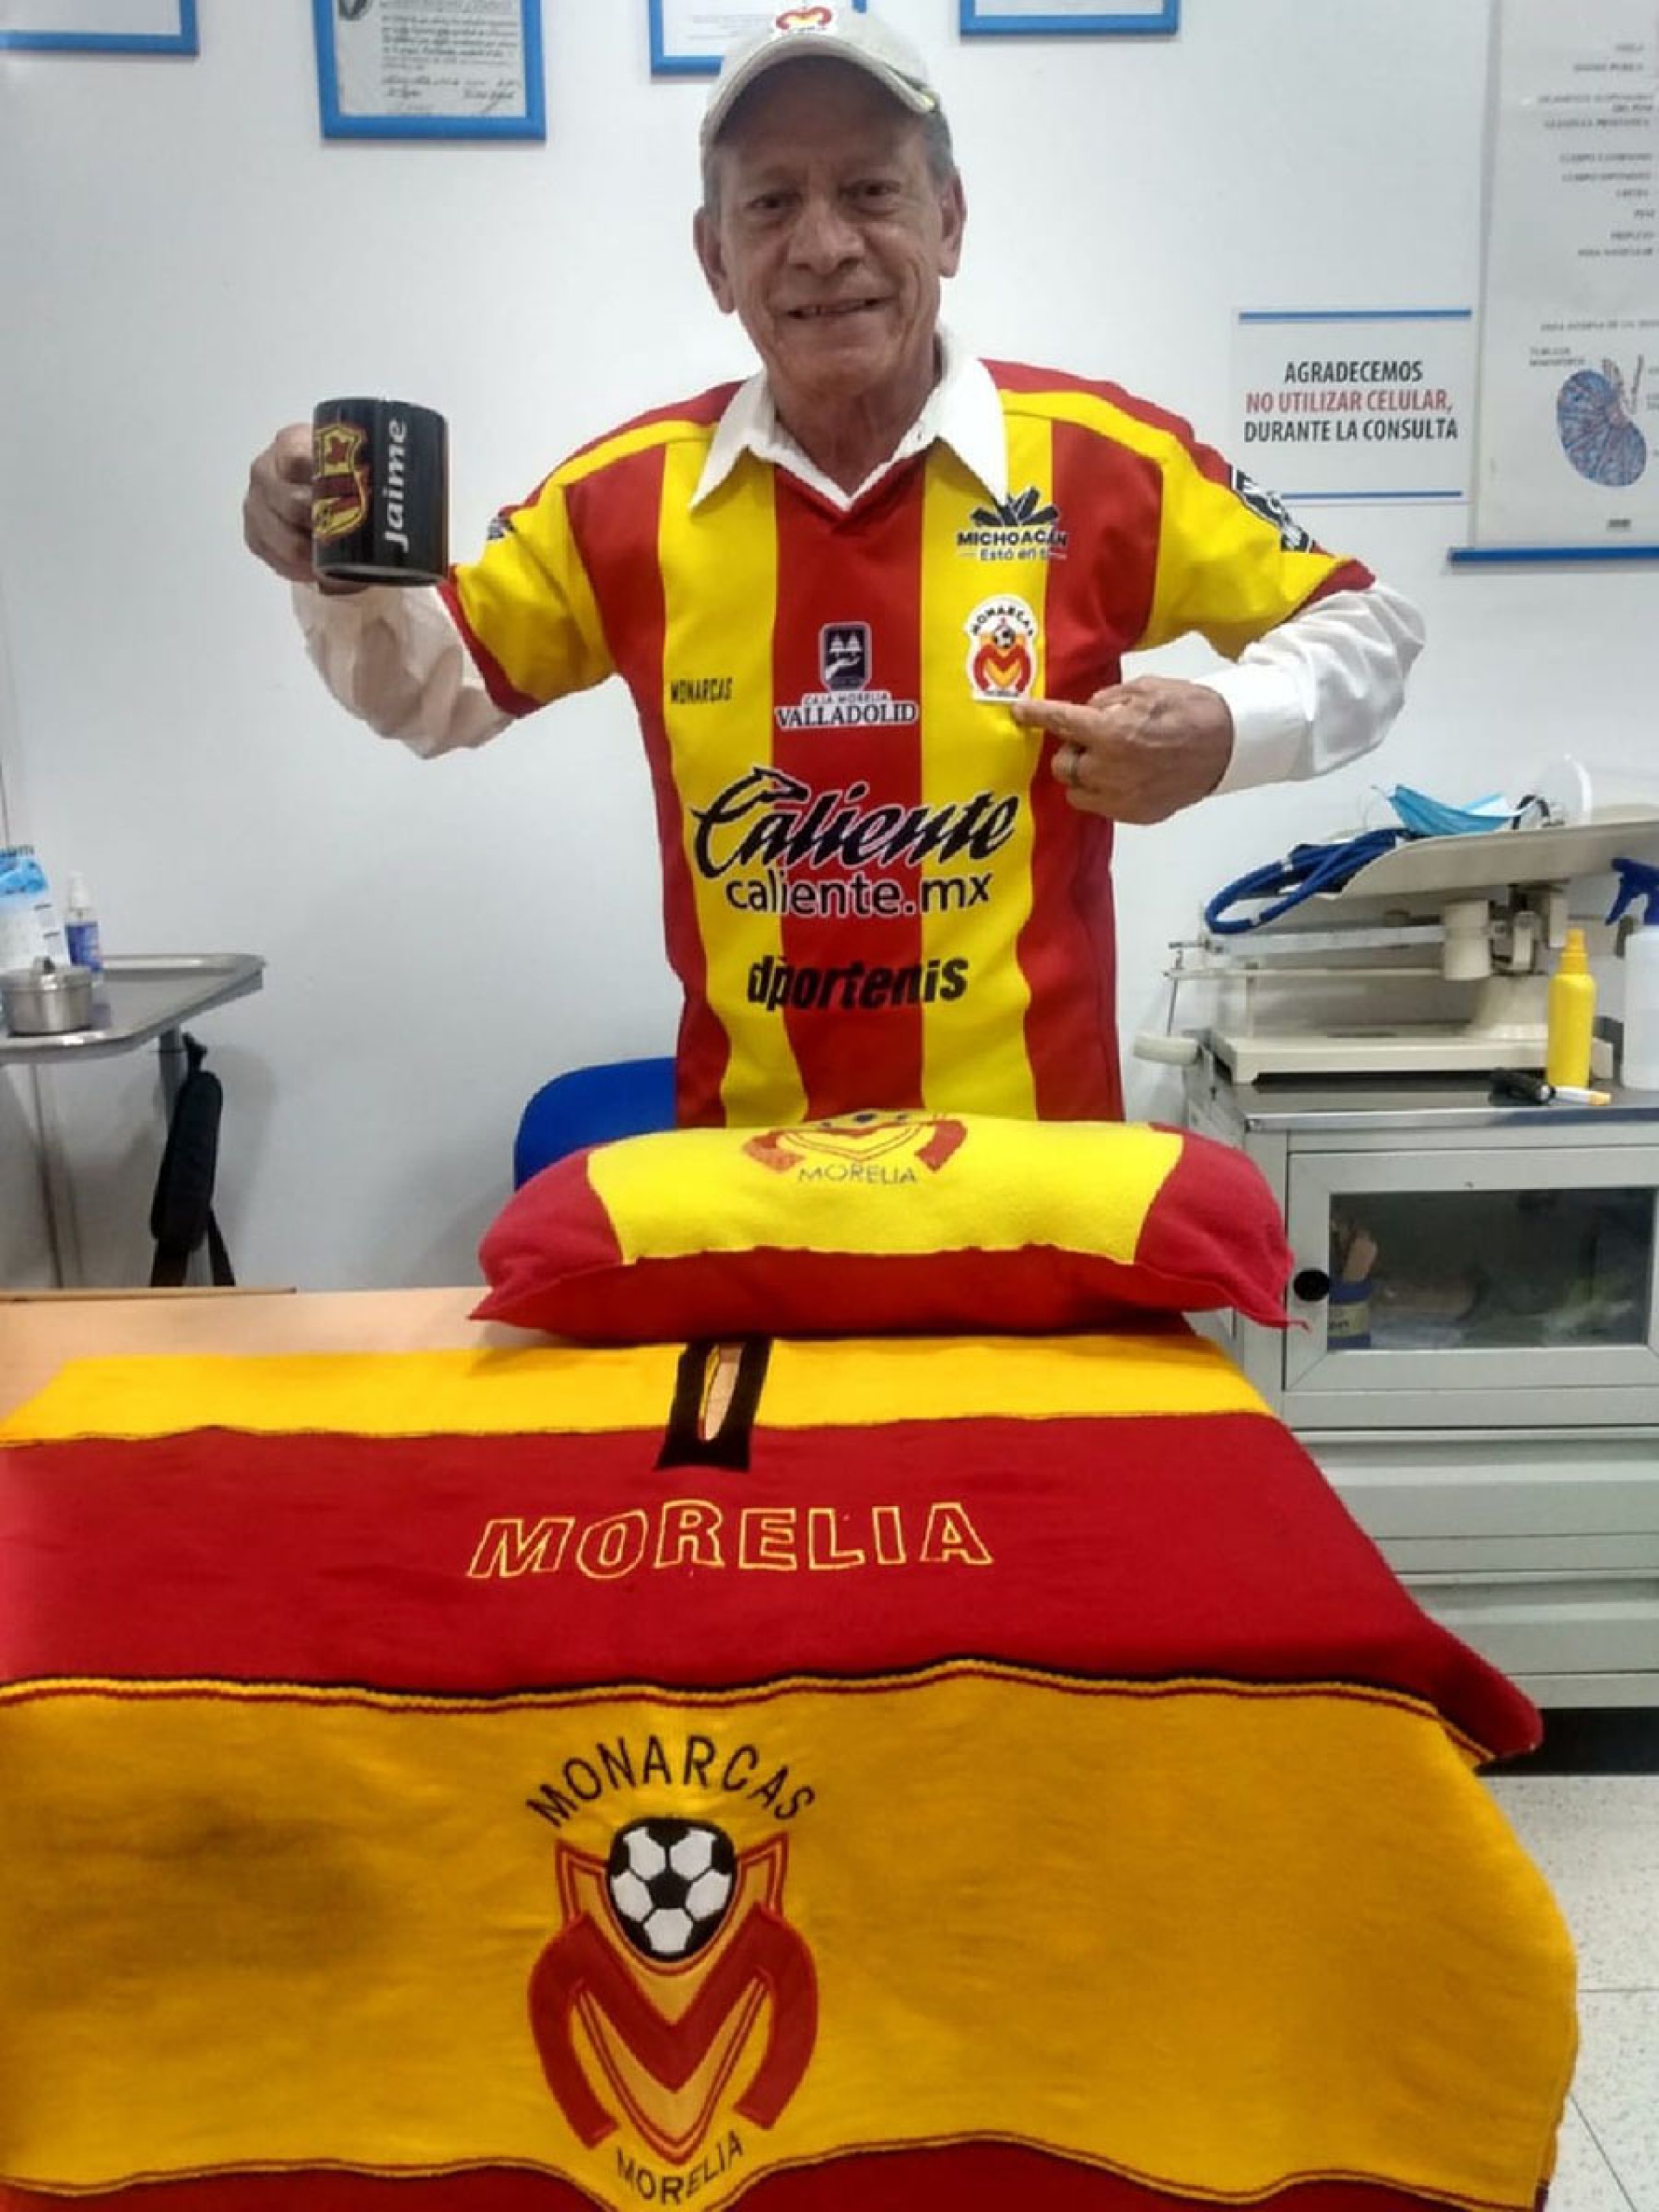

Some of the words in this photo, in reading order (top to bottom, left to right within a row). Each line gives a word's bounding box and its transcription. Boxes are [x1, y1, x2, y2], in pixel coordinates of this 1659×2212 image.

[1285, 360, 1423, 383] AGRADECEMOS
[1246, 391, 1274, 413] NO
[1279, 391, 1362, 413] UTILIZAR
[1367, 389, 1453, 414] CELULAR,
[1244, 420, 1331, 442] DURANTE
[1337, 420, 1357, 442] LA
[1363, 418, 1459, 441] CONSULTA
[383, 418, 410, 553] Jaime
[671, 677, 733, 704] MONARCAS
[778, 702, 916, 727] VALLADOLID
[691, 766, 1020, 878] Caliente
[726, 870, 994, 915] caliente.mx
[798, 1164, 918, 1184] MORELIA
[467, 1499, 993, 1580] MORELIA
[525, 1734, 816, 1827] MONARCAS
[616, 2129, 744, 2205] MORELIA
